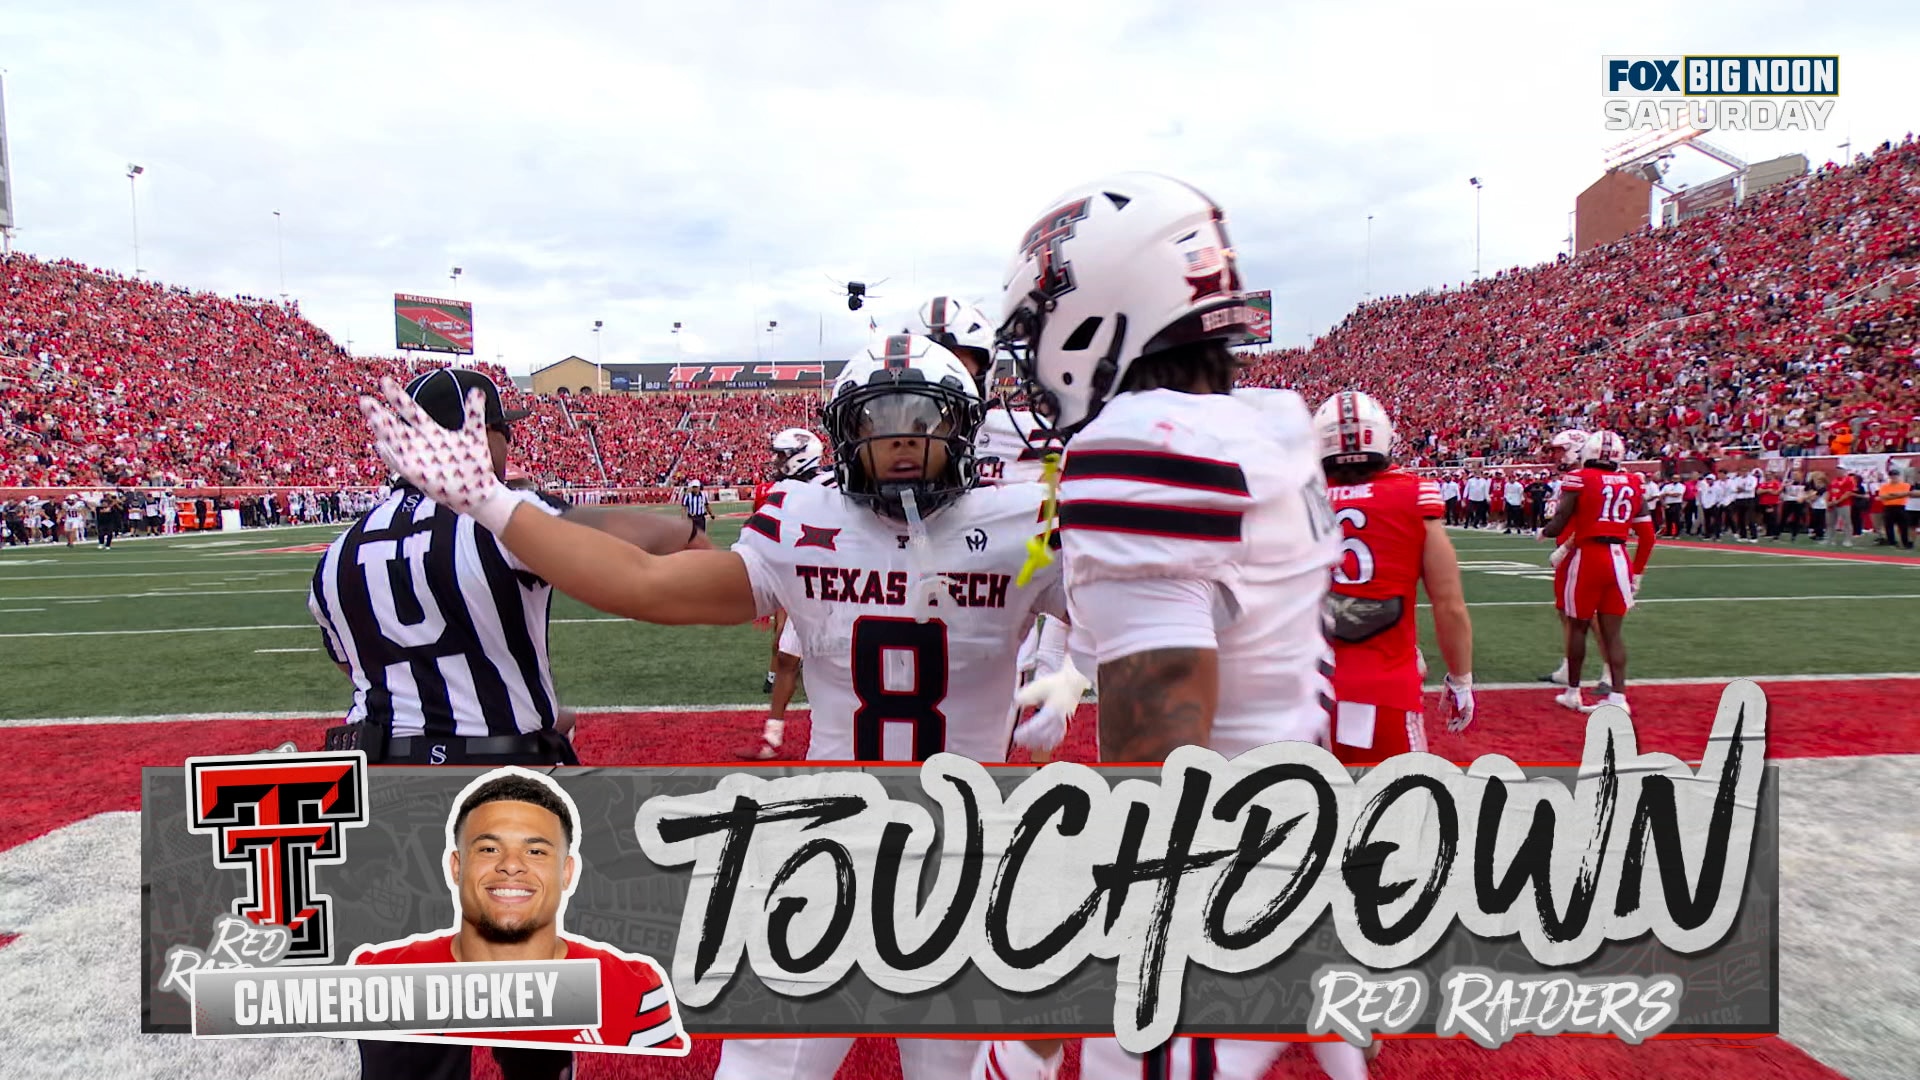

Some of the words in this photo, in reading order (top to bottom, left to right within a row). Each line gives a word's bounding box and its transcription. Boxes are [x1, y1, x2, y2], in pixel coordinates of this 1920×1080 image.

[979, 461, 1005, 478] CH
[1327, 483, 1375, 502] ITCHIE
[1598, 485, 1635, 524] 16
[357, 530, 447, 648] U
[795, 565, 908, 606] TEXAS
[929, 572, 1011, 608] ECH
[851, 614, 949, 761] 8
